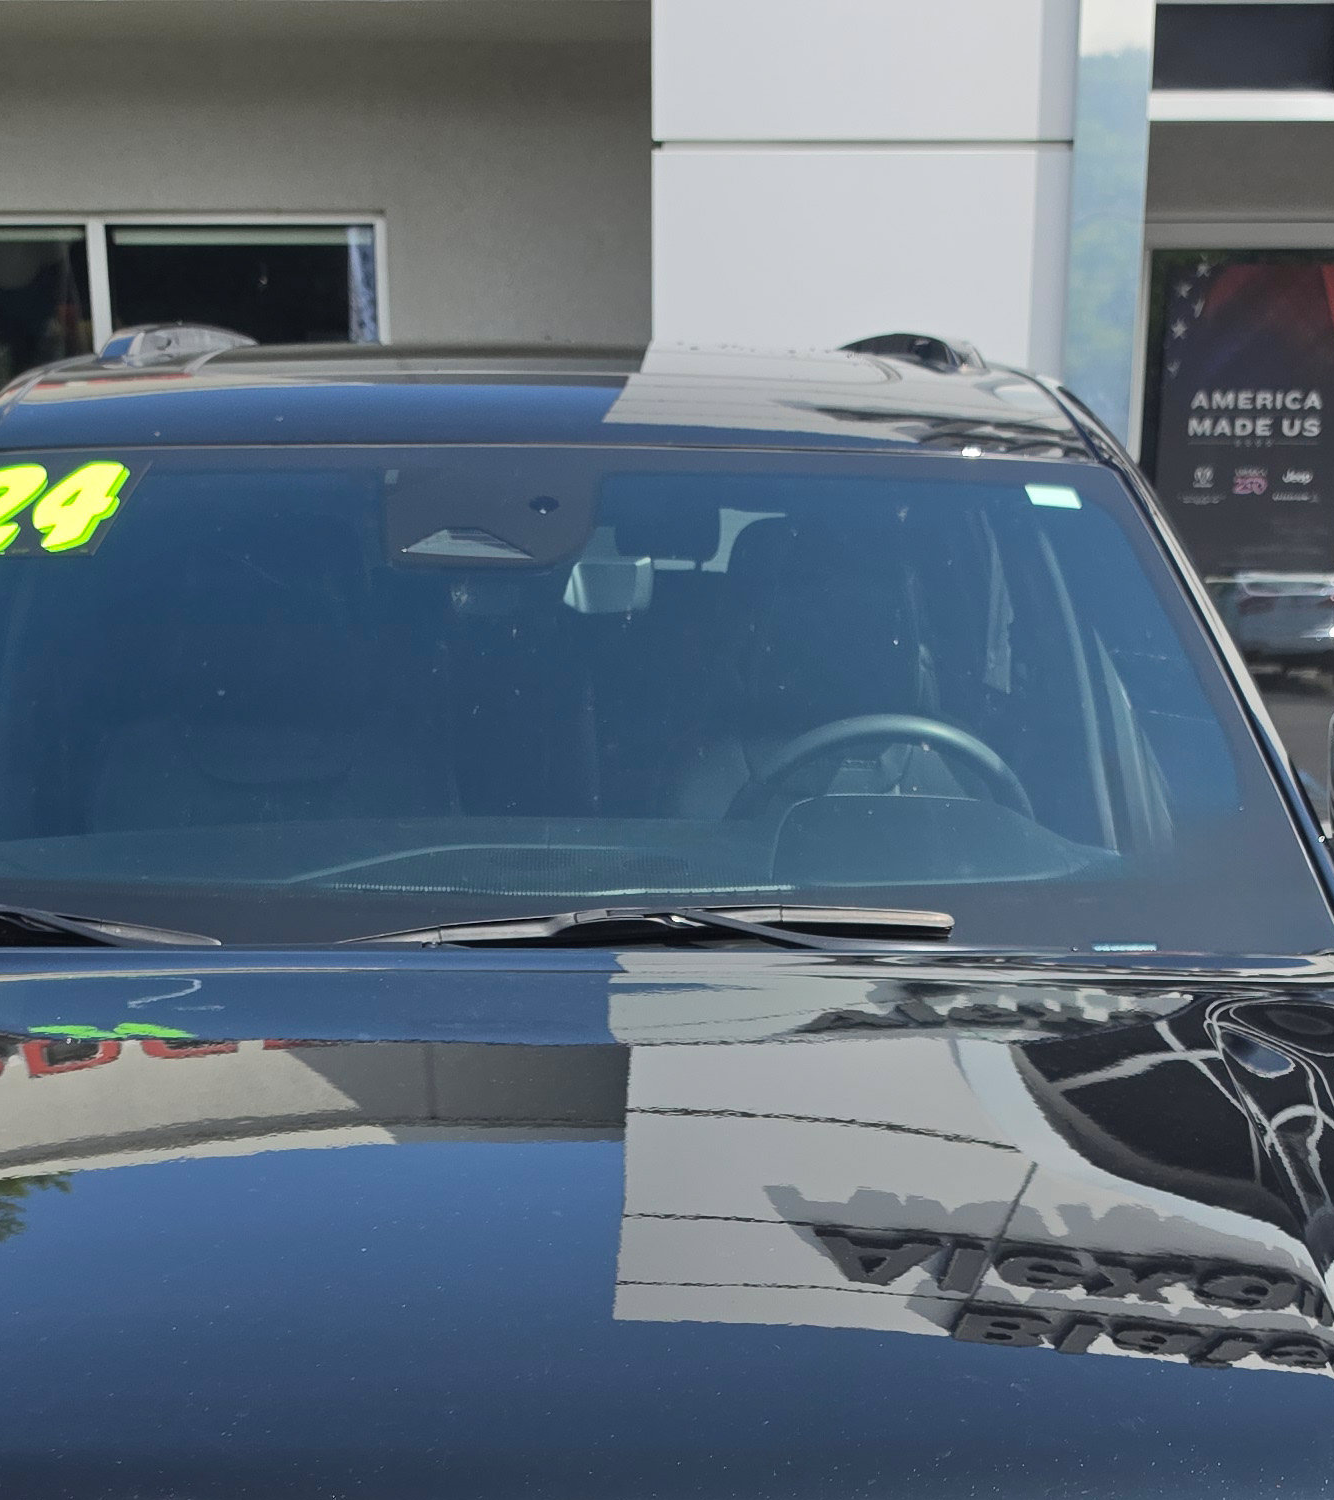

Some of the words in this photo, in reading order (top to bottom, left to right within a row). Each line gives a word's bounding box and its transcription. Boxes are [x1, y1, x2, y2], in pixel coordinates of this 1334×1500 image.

[1190, 388, 1323, 410] AMERICA
[1187, 417, 1274, 437] MADE
[1281, 417, 1322, 437] US
